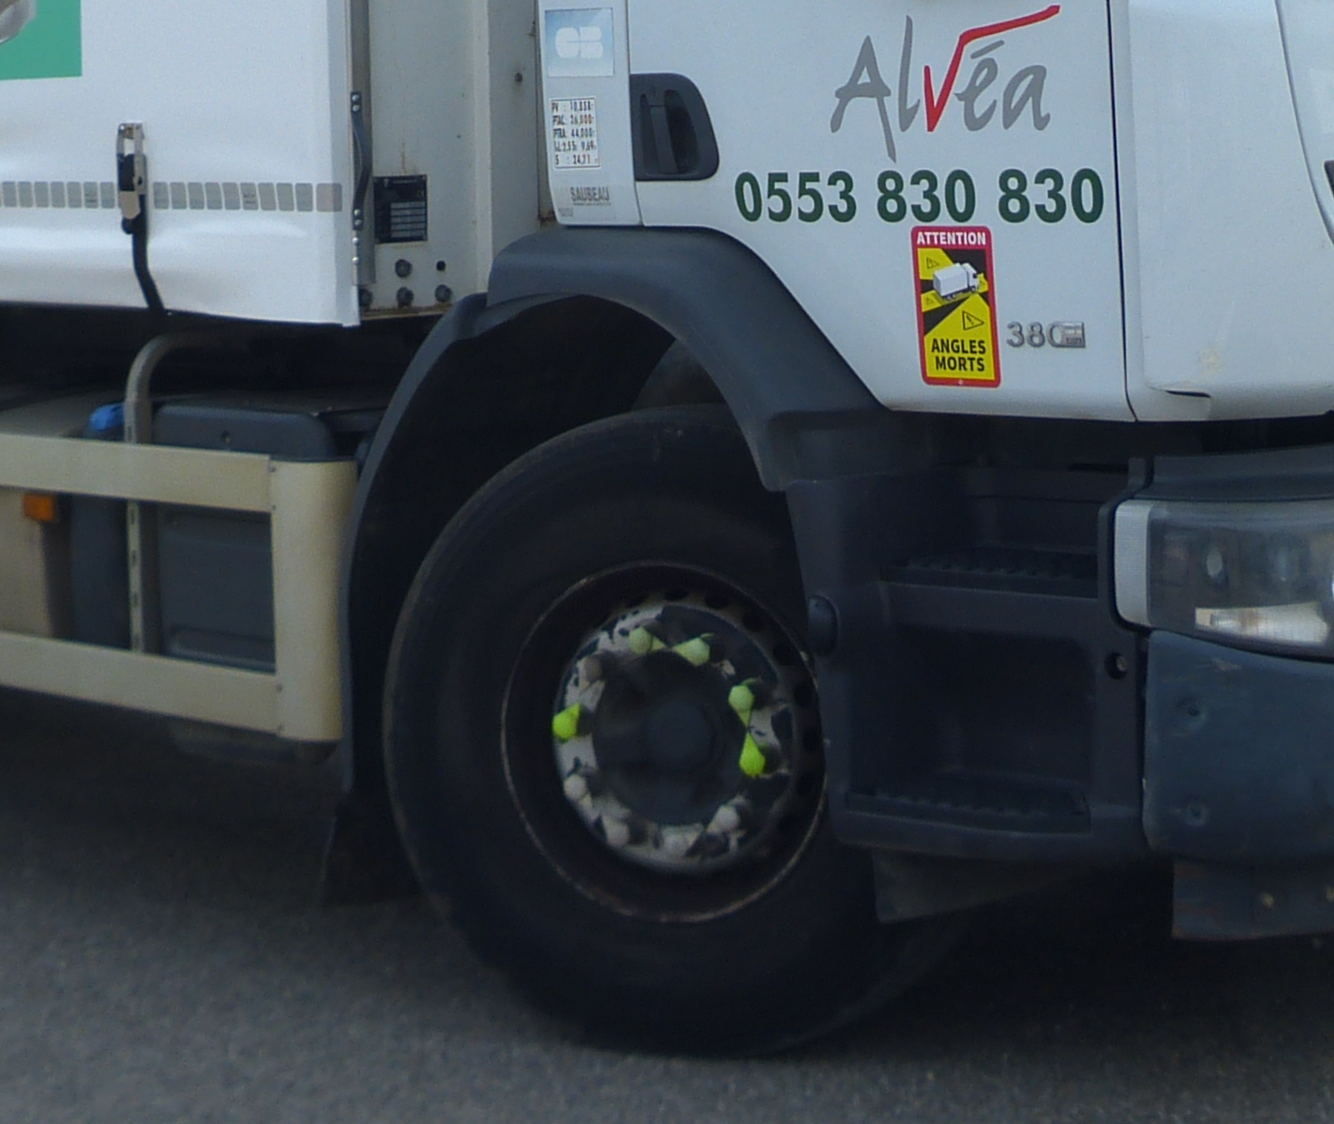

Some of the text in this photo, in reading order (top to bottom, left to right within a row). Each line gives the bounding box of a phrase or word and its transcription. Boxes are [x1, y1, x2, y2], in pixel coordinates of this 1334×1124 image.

[830, 4, 1061, 164] Alvéa
[734, 168, 1105, 223] 0553 830 830
[917, 231, 987, 246] ATTENTION
[931, 338, 987, 355] ANGLES
[935, 356, 985, 373] MORTS
